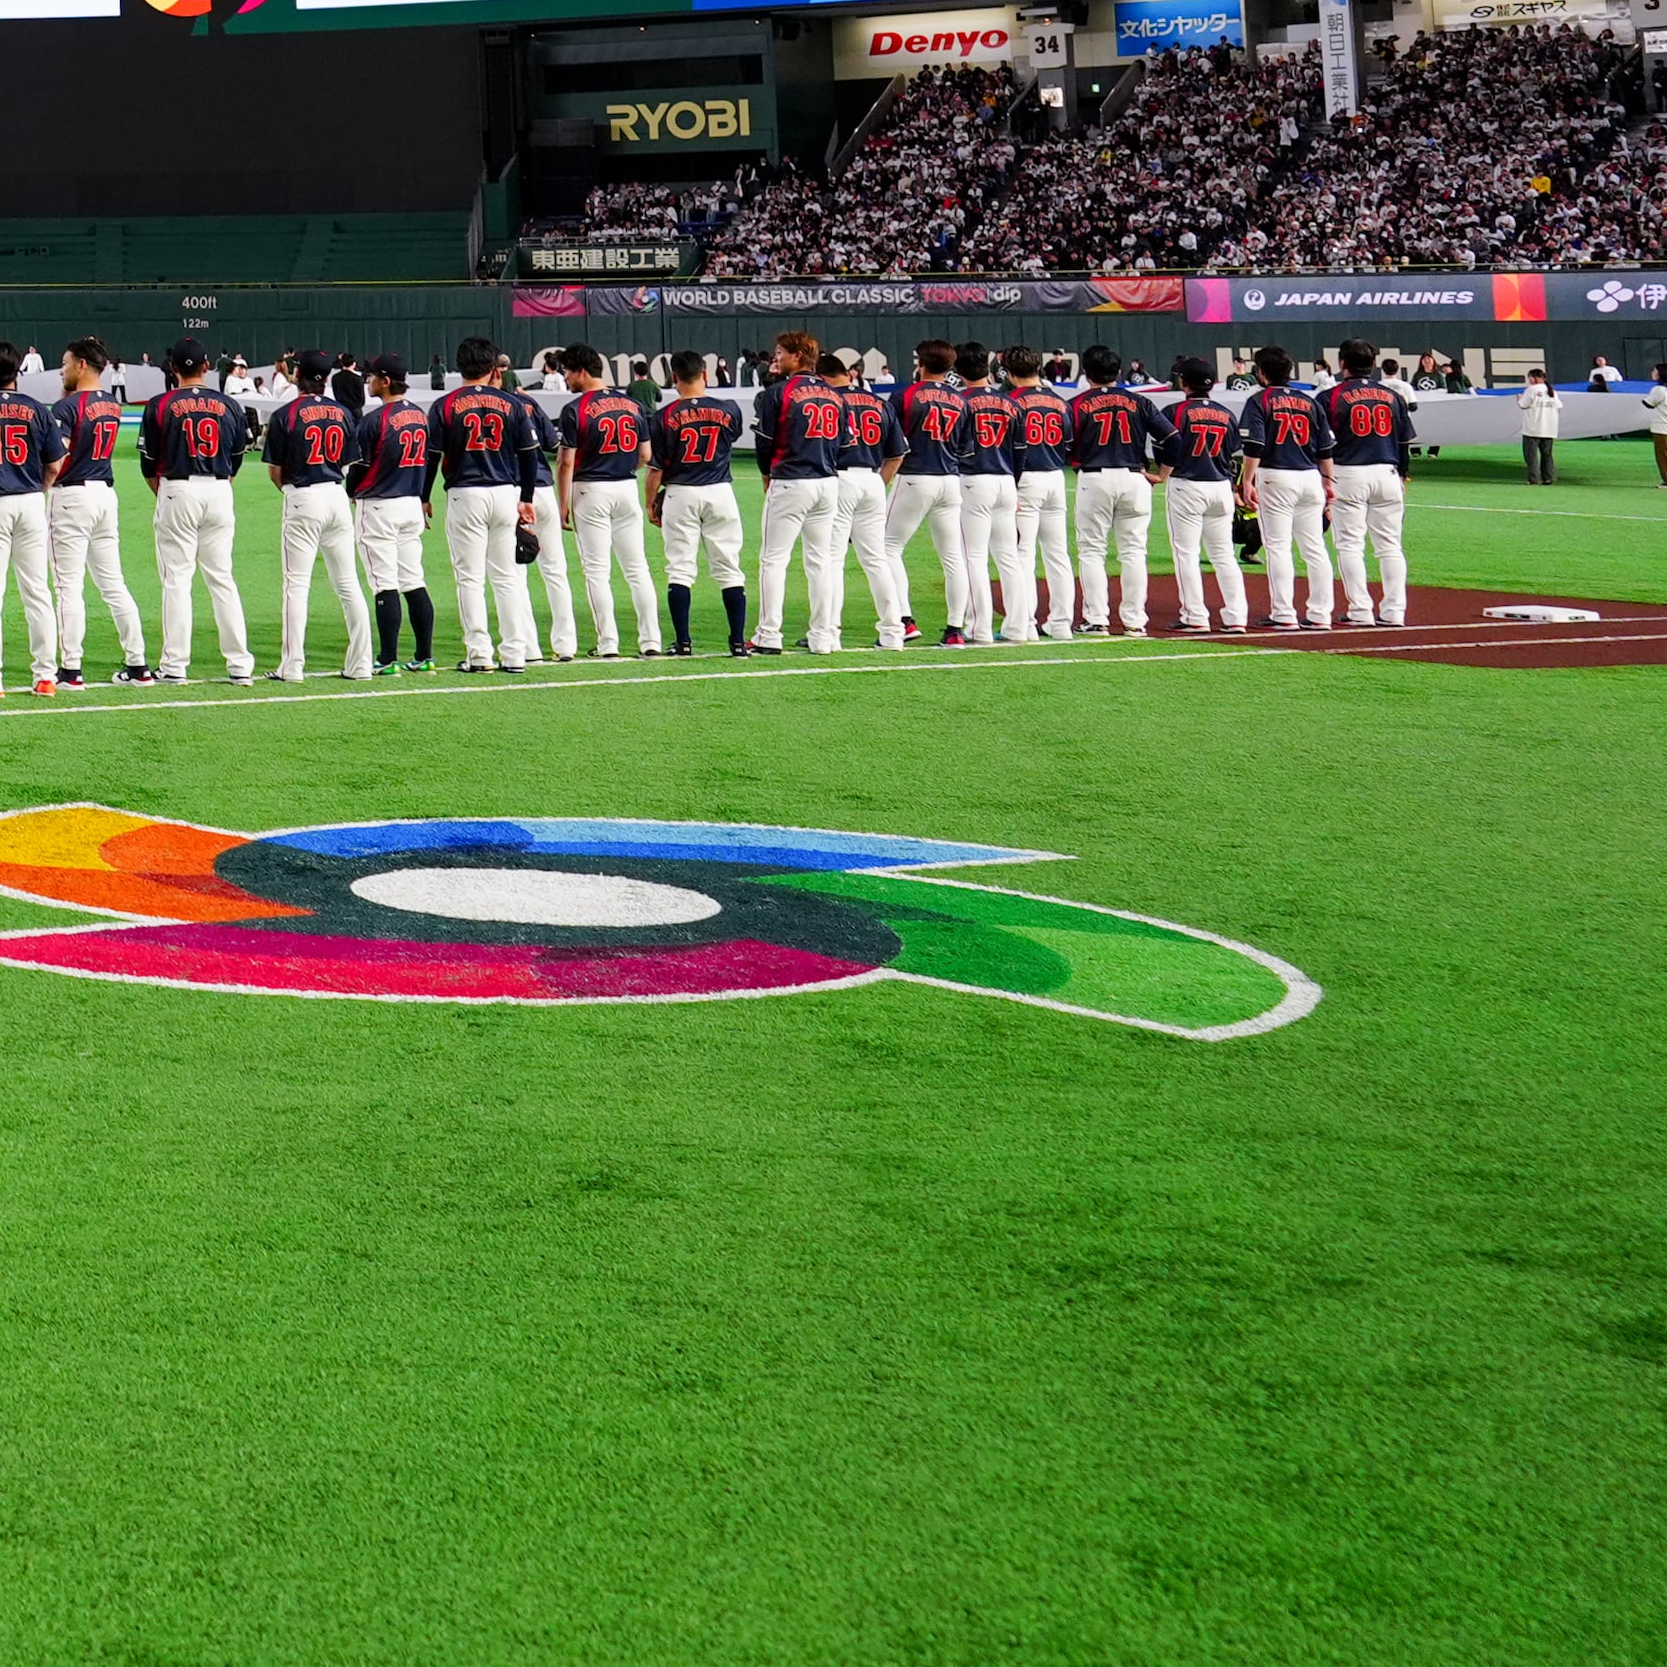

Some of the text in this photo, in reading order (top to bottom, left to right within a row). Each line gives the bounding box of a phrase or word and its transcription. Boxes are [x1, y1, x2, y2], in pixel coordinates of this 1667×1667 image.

[1119, 13, 1240, 39] 文化シャッター
[1512, 0, 1567, 17] スギヤス
[869, 28, 1010, 58] Denyo
[1035, 35, 1059, 54] 34
[1327, 13, 1350, 112] 朝日工業社
[605, 98, 751, 142] RYOBI
[531, 246, 681, 271] 東亜建設工業
[181, 296, 218, 310] 400ft
[663, 286, 1022, 307] WORLD BASEBALL CLASSIC TOKYO dip
[1274, 290, 1475, 306] JAPAN AIRLINES
[182, 318, 210, 329] 122m
[181, 417, 221, 459] 19
[463, 412, 505, 452] 23
[597, 414, 639, 455] 26
[802, 402, 840, 440] 28
[921, 405, 962, 442] 47
[974, 412, 1011, 449] 57
[1024, 410, 1064, 447] 66
[1093, 410, 1133, 447] 71
[1273, 412, 1311, 447] 79
[1349, 404, 1394, 438] 88
[91, 421, 119, 461] 17
[304, 424, 345, 465] 20
[398, 428, 428, 469] 22
[679, 426, 722, 464] 27
[1190, 423, 1229, 457] 77
